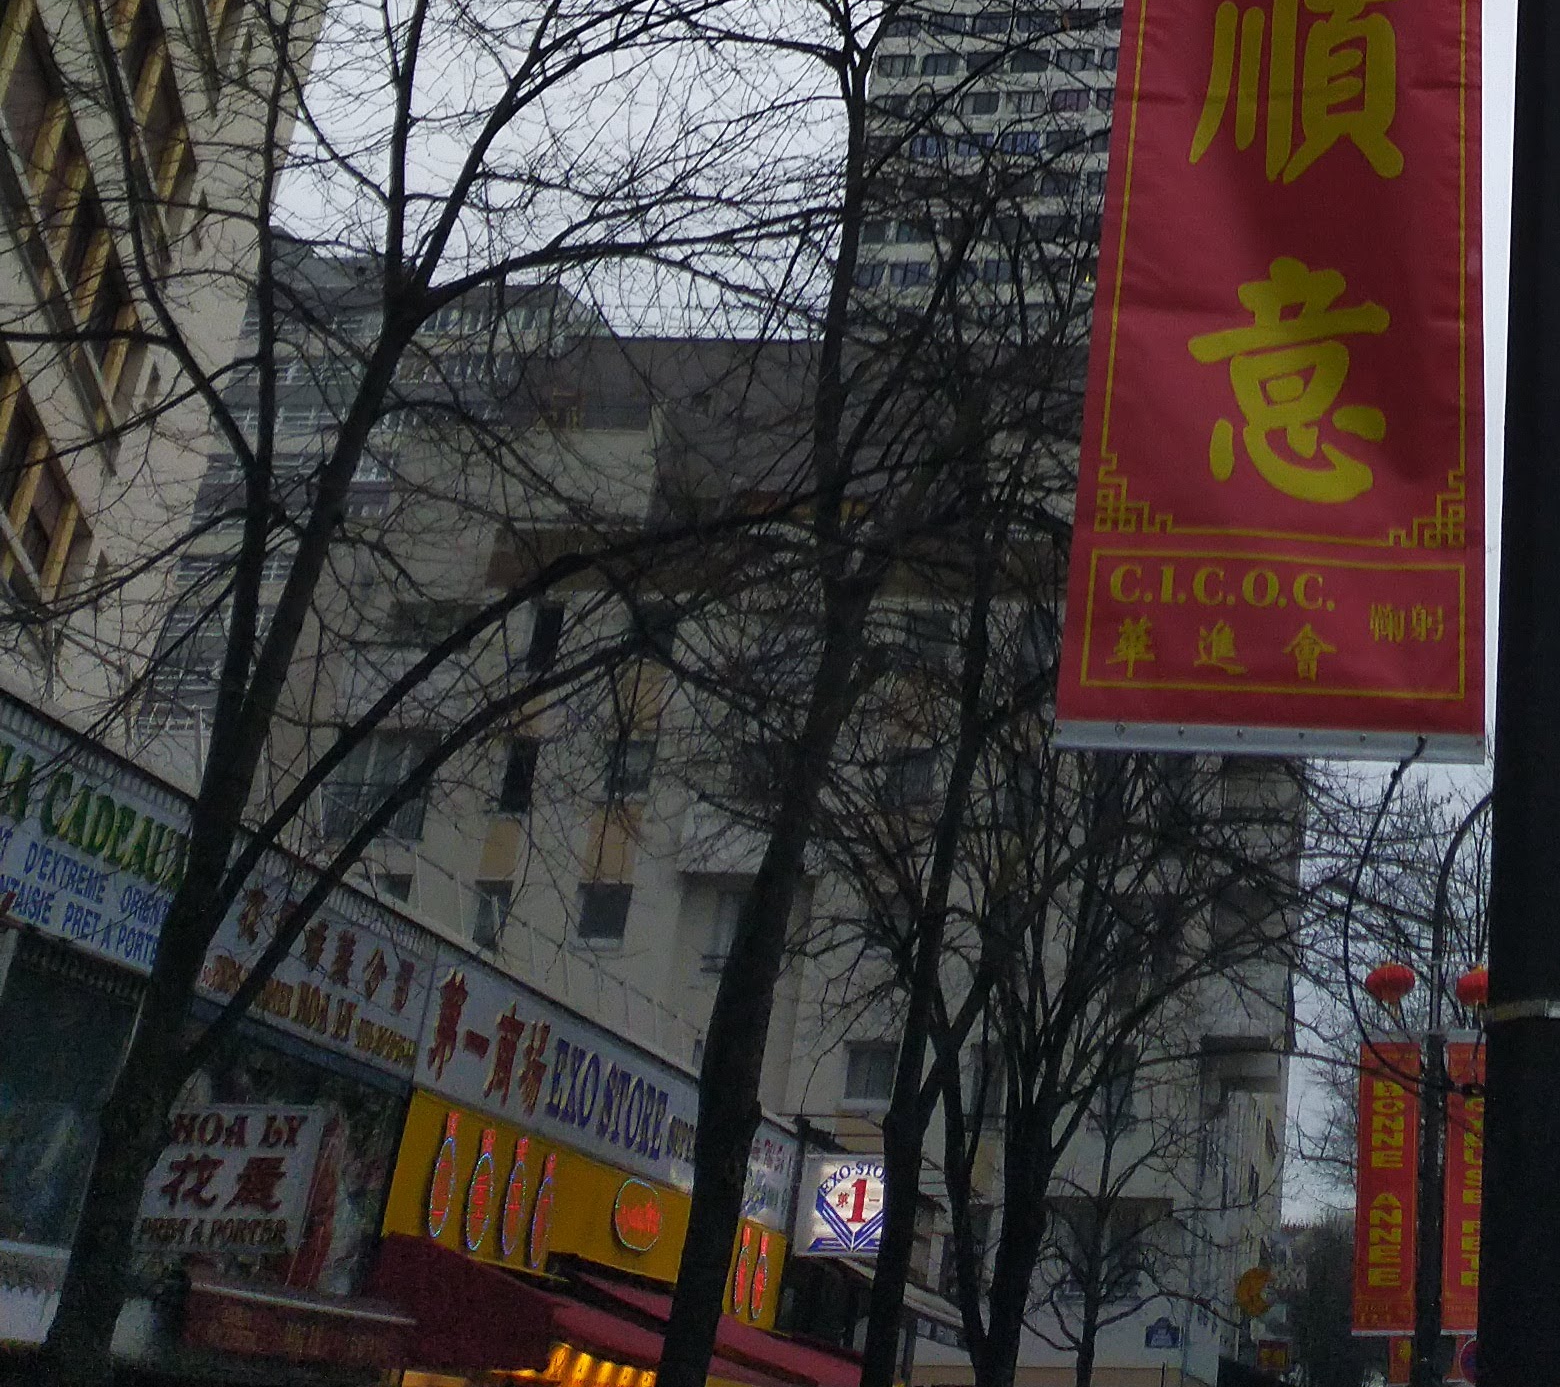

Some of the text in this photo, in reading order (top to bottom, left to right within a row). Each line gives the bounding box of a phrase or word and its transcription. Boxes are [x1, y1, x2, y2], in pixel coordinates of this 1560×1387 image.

[1109, 565, 1336, 612] C.I.C.O.C.
[23, 840, 106, 906] D'EXTREME
[62, 901, 103, 943] PRET
[545, 1037, 600, 1128] EXO
[596, 1061, 669, 1161] STORE
[846, 1178, 868, 1224] 1
